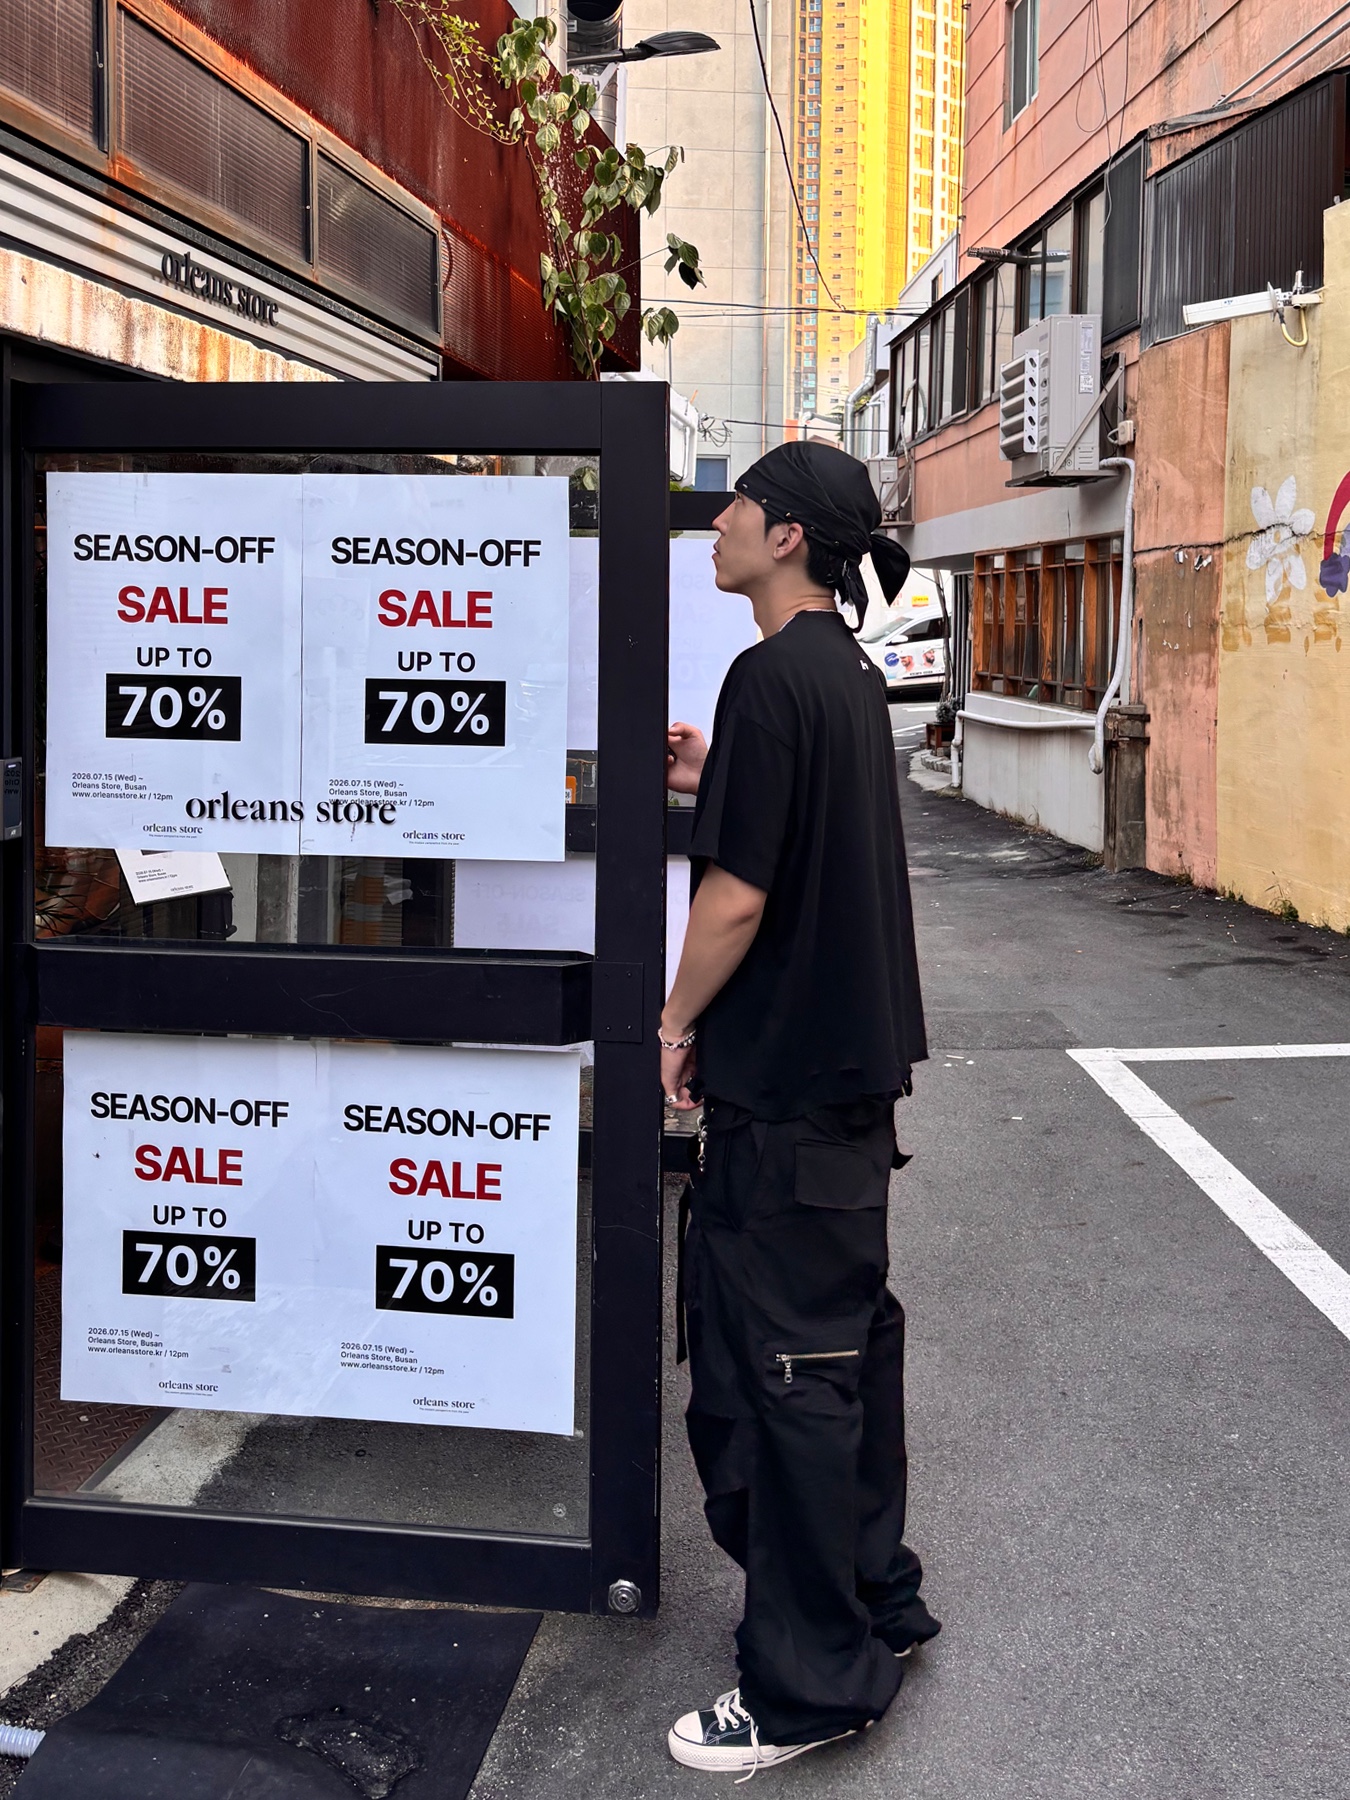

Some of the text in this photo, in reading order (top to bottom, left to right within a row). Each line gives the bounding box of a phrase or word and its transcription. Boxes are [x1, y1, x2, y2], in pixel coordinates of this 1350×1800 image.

[161, 252, 279, 326] orleans store
[74, 534, 275, 564] SEASON-OFF
[331, 537, 541, 567] SEASON-OFF
[118, 586, 228, 624] SALE
[378, 589, 492, 628] SALE
[137, 647, 212, 668] UP TO
[398, 651, 475, 673] UP TO
[119, 686, 226, 730] 70%
[379, 691, 489, 735] 70%
[102, 783, 122, 791] Store,
[125, 783, 146, 791] Busan
[115, 774, 136, 782] (Wed)
[329, 779, 371, 787] 2026.07.15
[374, 781, 396, 789] (Wed)
[72, 791, 146, 800] www.orleansstore.kr
[154, 793, 173, 801] 12pm
[360, 789, 382, 797] Store,
[186, 791, 396, 824] orleans store
[414, 800, 434, 808] 12pm
[143, 824, 203, 834] orleans store
[403, 830, 465, 840] orleans store
[91, 1092, 289, 1128] SEASON-OFF
[343, 1104, 551, 1141] SEASON-OFF
[134, 1144, 243, 1186] SALE
[389, 1158, 502, 1201] SALE
[153, 1205, 227, 1228] UP TO
[408, 1220, 484, 1244] UP TO
[136, 1243, 240, 1290] 70%
[389, 1258, 498, 1306] 70%
[88, 1328, 129, 1336] 2026.07.15
[131, 1330, 153, 1339] (Wed)
[117, 1338, 138, 1347] Store,
[88, 1346, 162, 1356] www.orleansstore.kr
[170, 1350, 189, 1358] 12pm
[341, 1342, 382, 1352] 2026.07.15
[385, 1346, 407, 1354] (Wed)
[341, 1351, 369, 1360] Orleans
[371, 1353, 392, 1362] Store,
[341, 1361, 417, 1373] www.orleansstore.kr
[424, 1367, 444, 1375] 12pm
[159, 1380, 218, 1392] orleans store
[413, 1397, 475, 1409] orleans store
